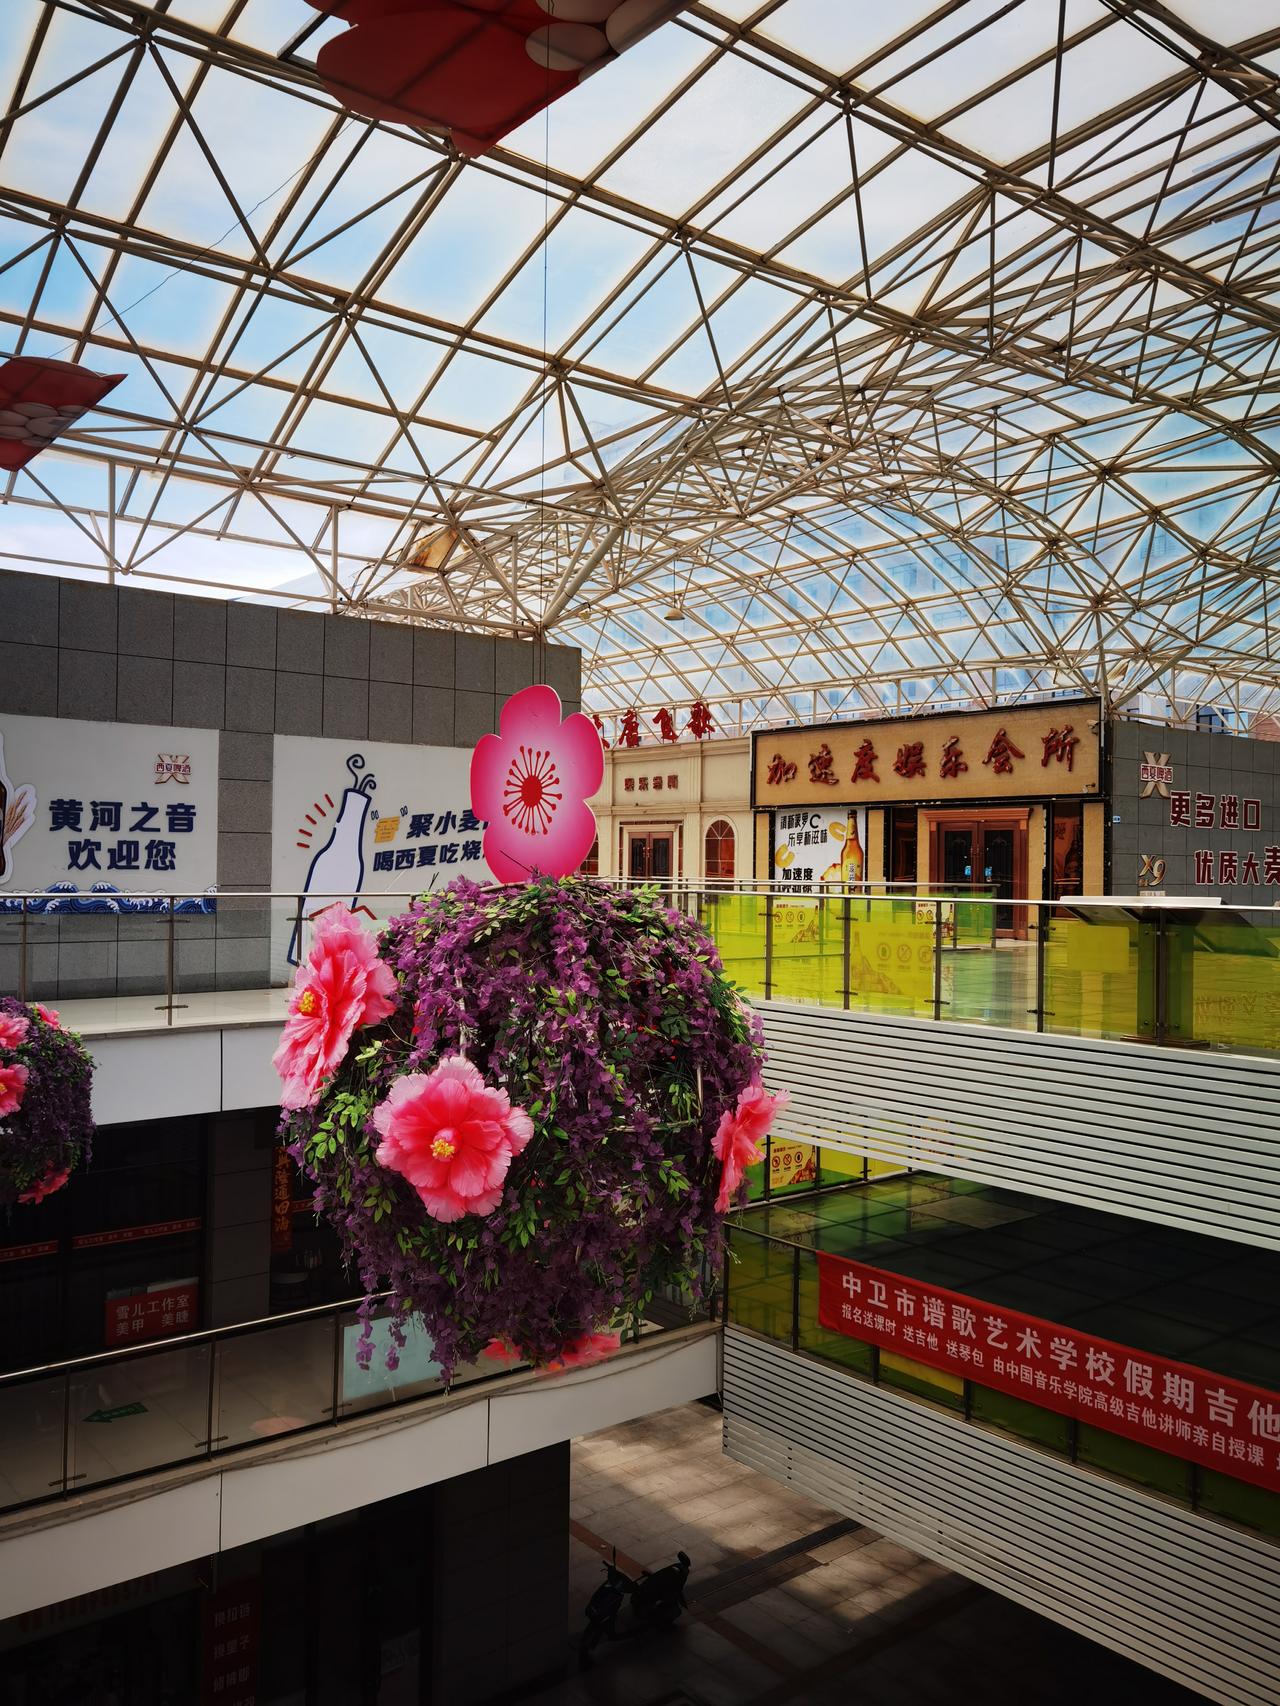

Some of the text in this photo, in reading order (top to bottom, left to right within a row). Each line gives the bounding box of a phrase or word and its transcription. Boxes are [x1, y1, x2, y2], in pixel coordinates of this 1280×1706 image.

[767, 724, 1080, 785] 加速度娱乐会所
[1141, 765, 1173, 782] 西夏啤酒
[48, 798, 197, 833] 黄河之音
[1169, 790, 1262, 831] 更多进口
[67, 837, 177, 872] 欢迎您
[373, 840, 486, 871] 喝西夏吃烧
[1139, 854, 1166, 886] X9
[782, 868, 813, 881] 加速度
[115, 1318, 144, 1337] 美甲
[841, 1303, 897, 1336] 报名送课时
[903, 1325, 939, 1352] 送吉他
[946, 1339, 985, 1369] 送琴包
[992, 1355, 1265, 1467] 由中国音乐学院高级吉他讲师亲自授课
